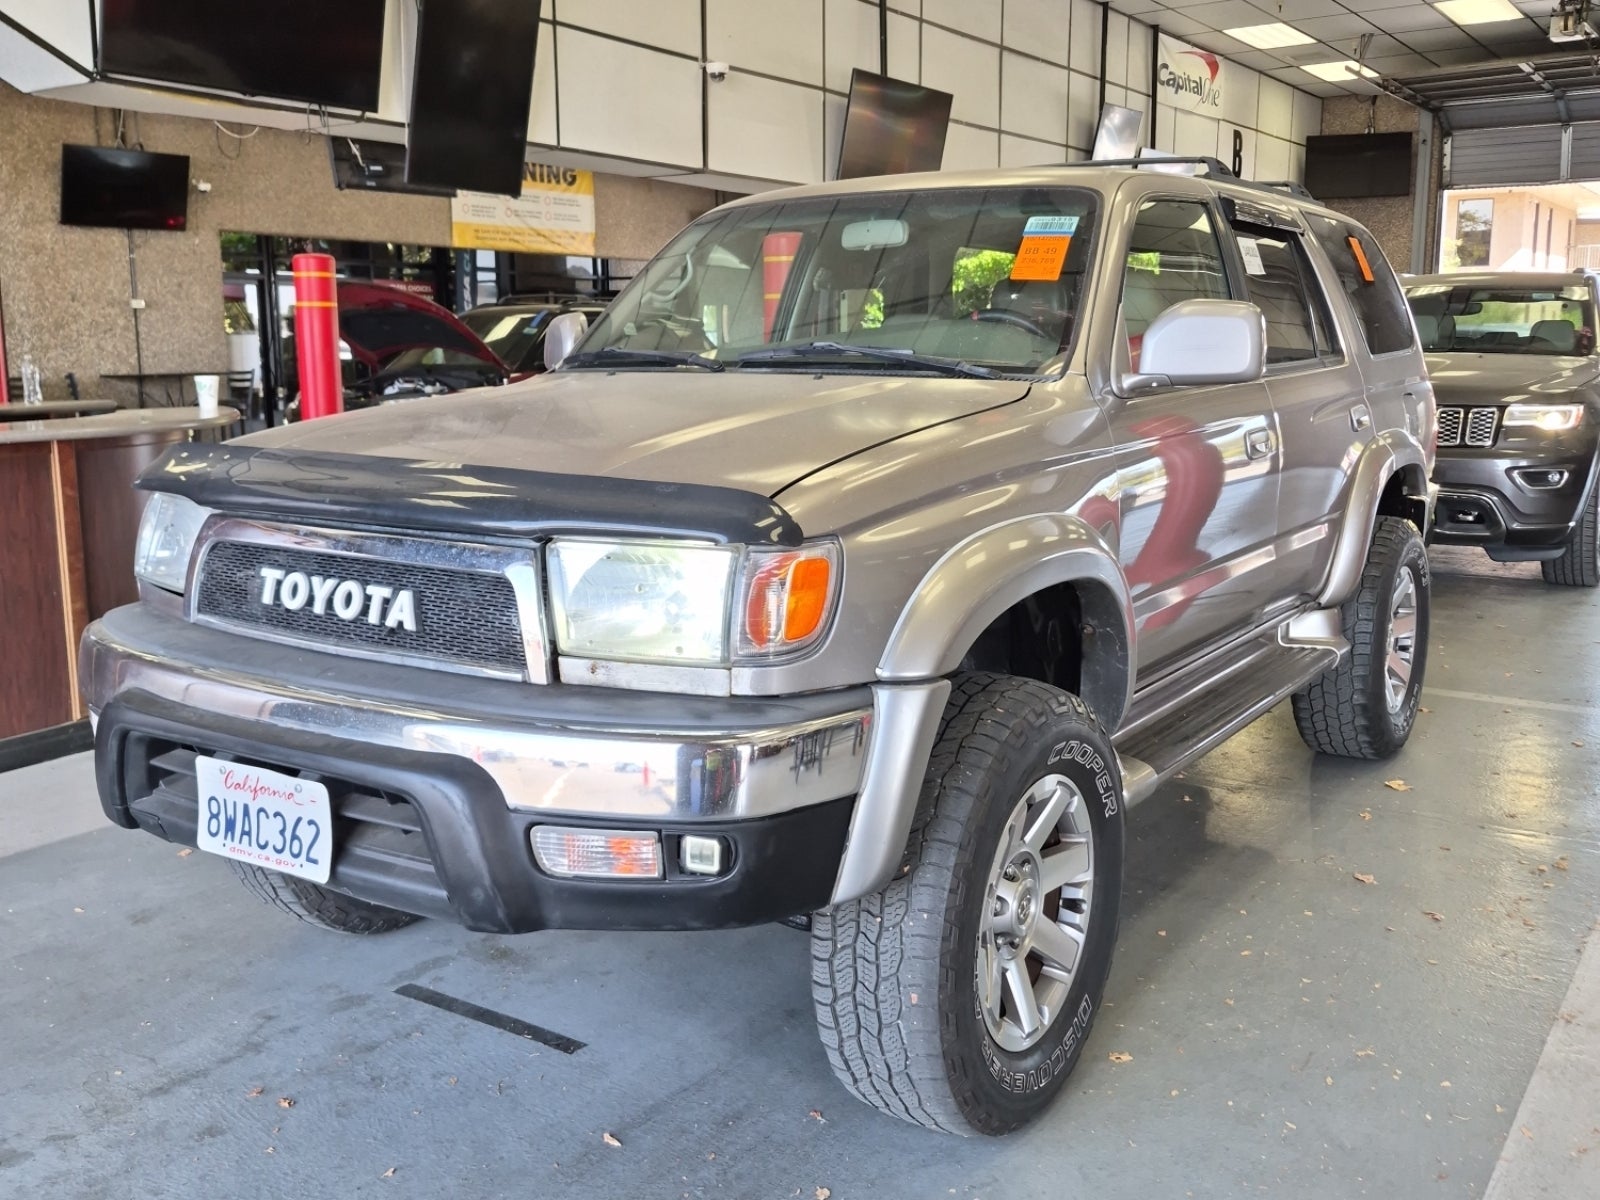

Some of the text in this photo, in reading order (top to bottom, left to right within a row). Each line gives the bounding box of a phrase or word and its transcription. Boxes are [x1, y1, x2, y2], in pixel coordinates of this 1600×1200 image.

[1232, 129, 1243, 179] B
[1043, 247, 1057, 255] 49
[260, 567, 417, 632] TOYOTA
[224, 769, 304, 806] California
[1047, 740, 1118, 818] COOPER
[207, 795, 320, 866] 8WAC362
[228, 845, 297, 869] dmv.ca.gov
[981, 993, 1093, 1093] DISCOVERER
